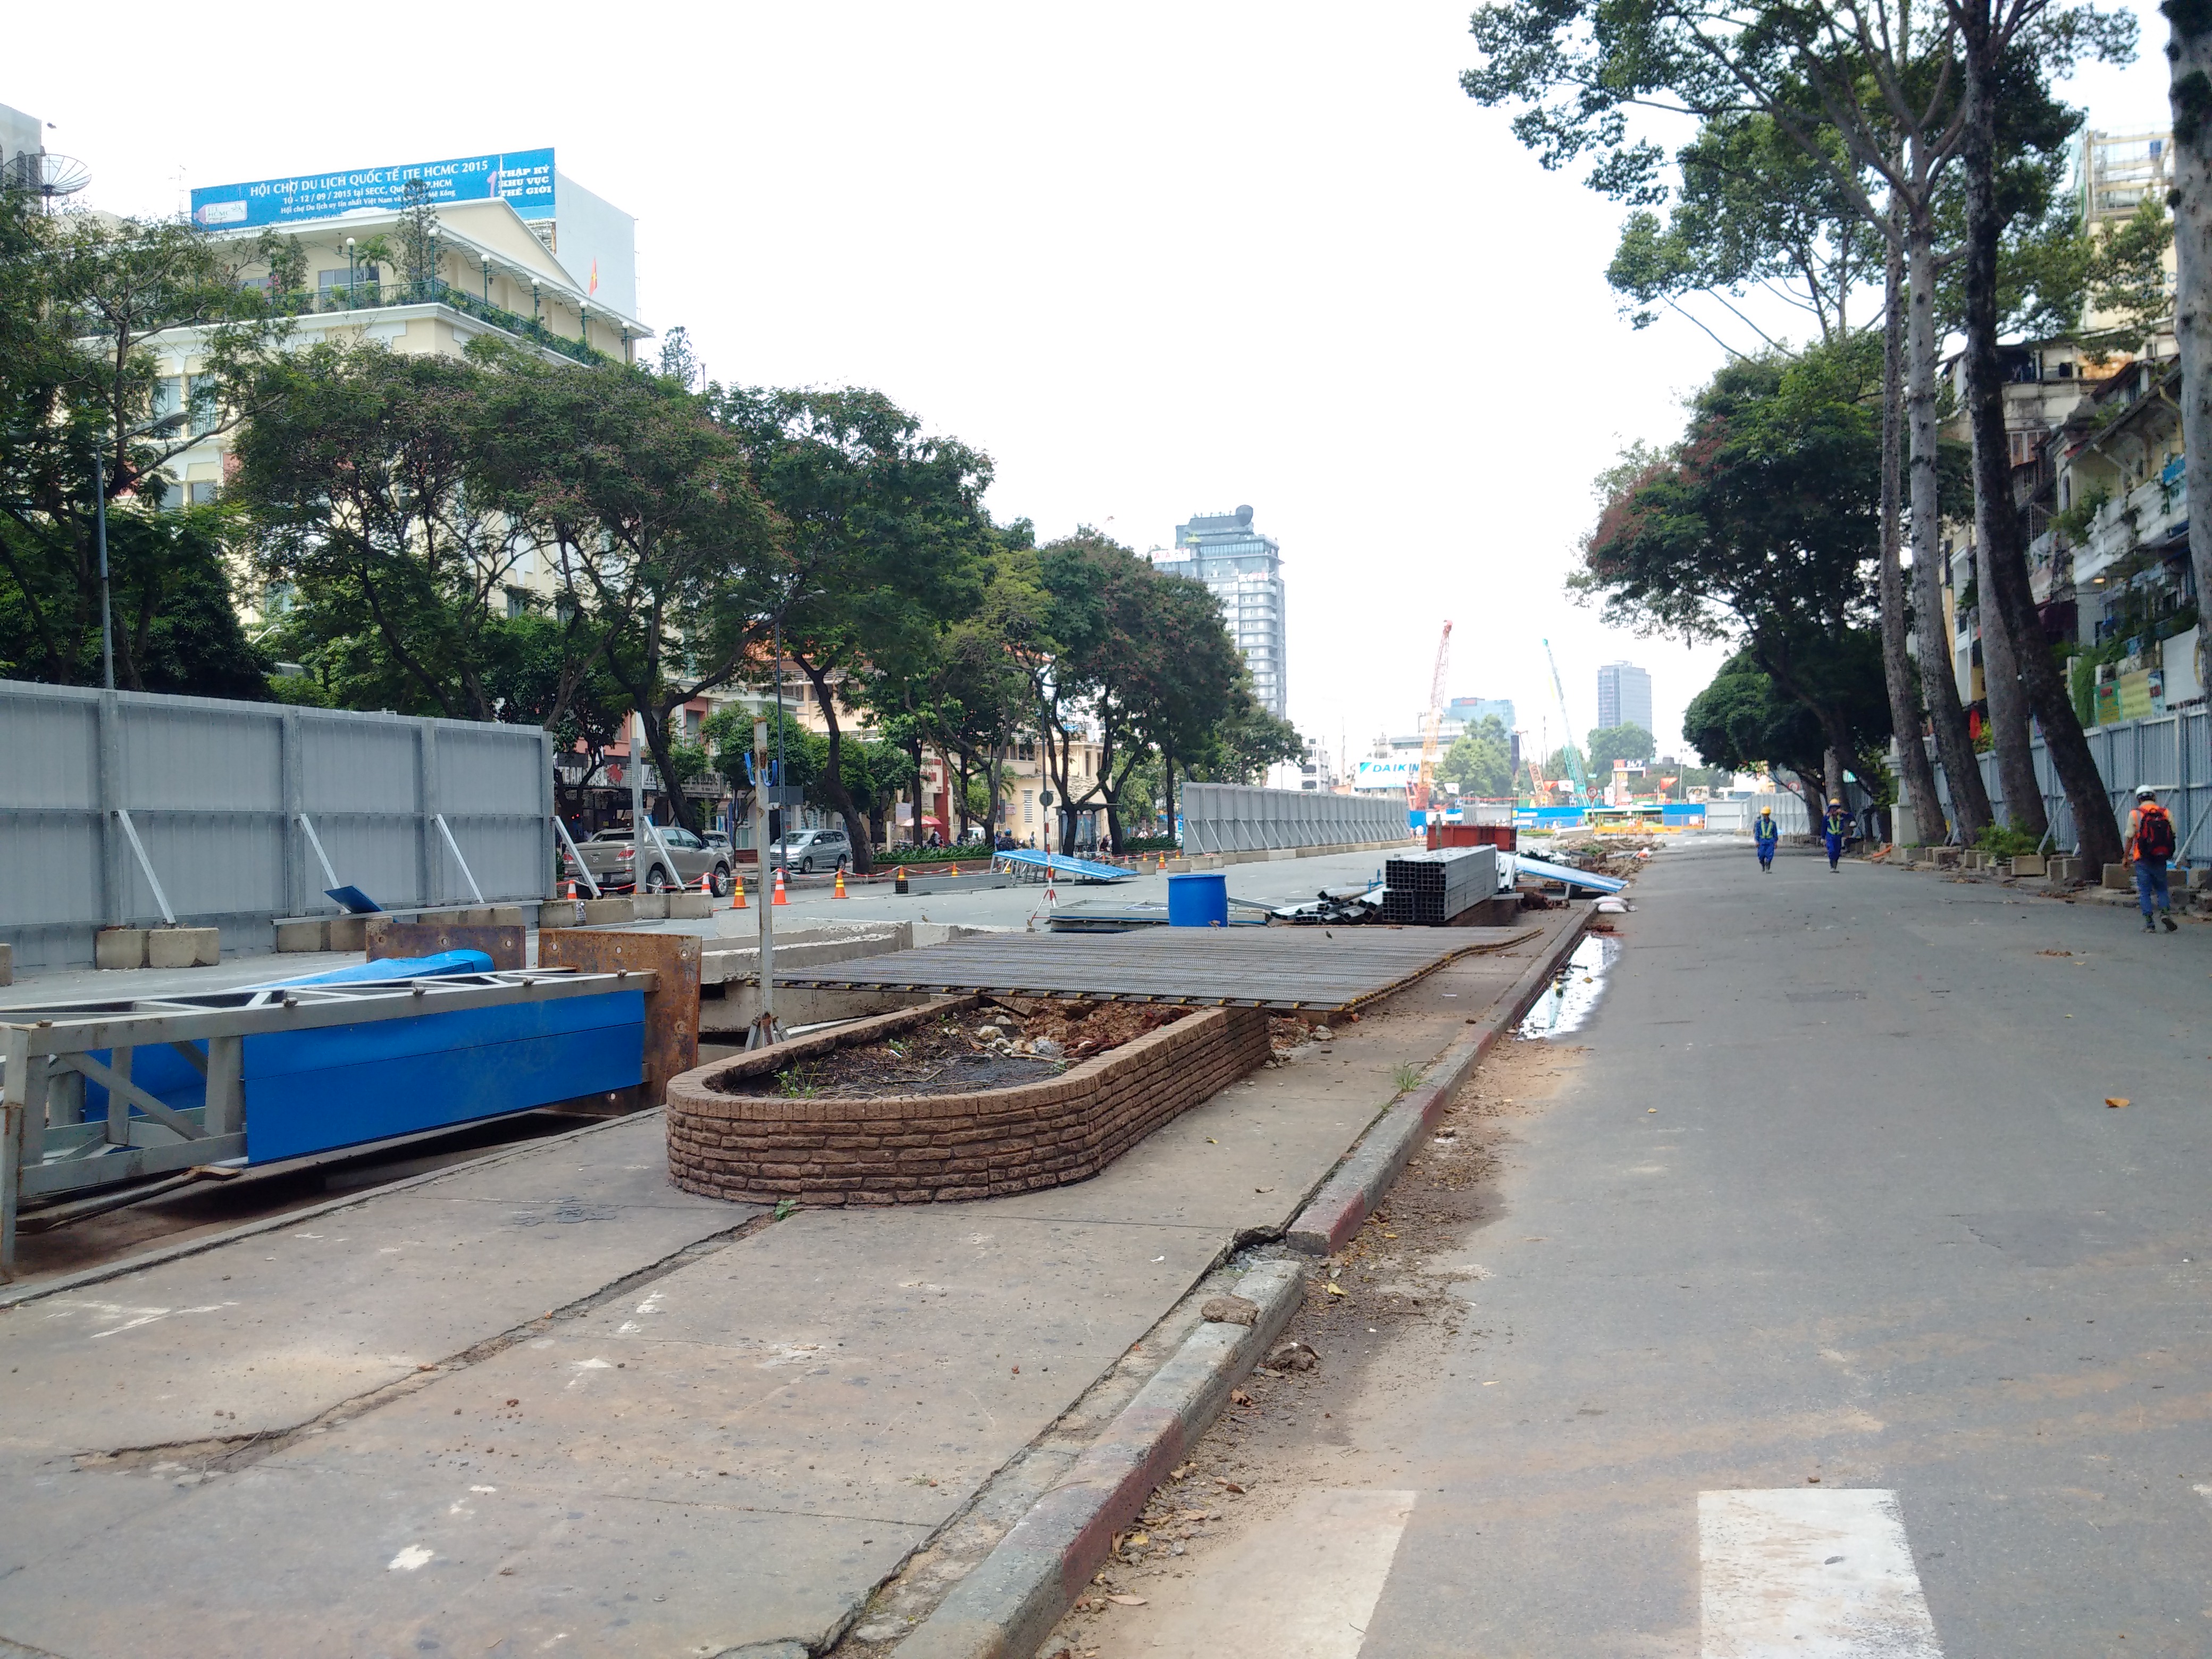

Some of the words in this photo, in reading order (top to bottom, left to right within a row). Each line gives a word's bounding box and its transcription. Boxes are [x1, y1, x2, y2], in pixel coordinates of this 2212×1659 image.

[498, 167, 531, 178] THẬP
[250, 183, 270, 197] HỘI
[273, 181, 298, 194] CHỢ
[301, 180, 317, 191] DU
[321, 176, 346, 190] LỊCH
[349, 169, 382, 186] QUỐC
[386, 166, 400, 181] TẾ
[403, 168, 420, 180] ITE
[424, 163, 458, 177] HCMC
[462, 160, 488, 173] 2015
[498, 179, 524, 187] KHU
[526, 176, 549, 186] VỰC
[333, 189, 351, 199] 2015
[354, 188, 363, 198] tại
[365, 186, 388, 195] SECC,
[498, 186, 523, 197] THẾ
[526, 185, 551, 195] GIỚI
[1373, 764, 1419, 773] DAIKIN
